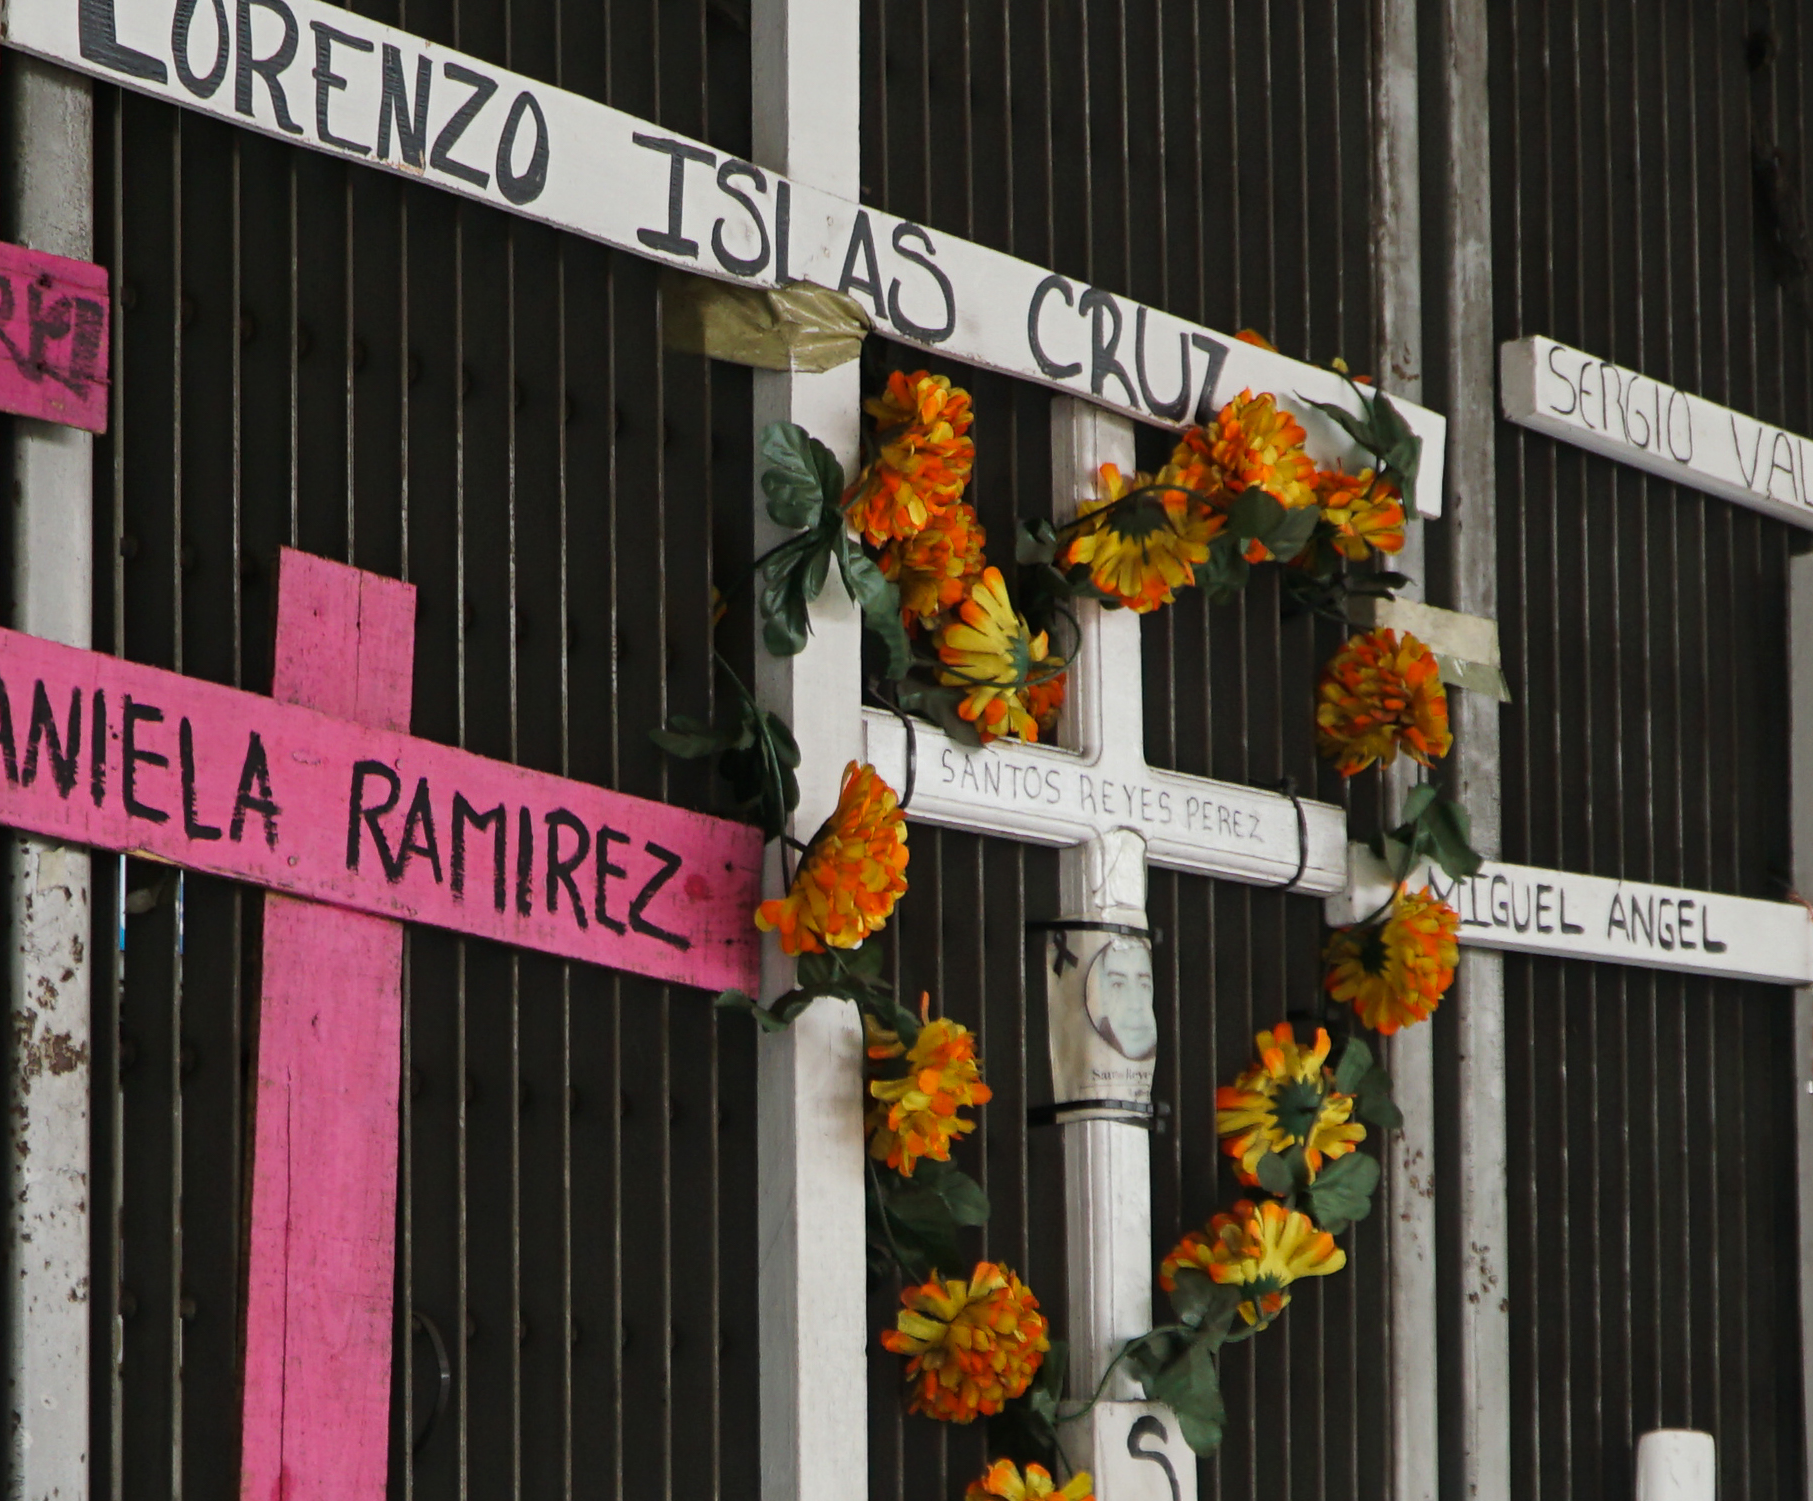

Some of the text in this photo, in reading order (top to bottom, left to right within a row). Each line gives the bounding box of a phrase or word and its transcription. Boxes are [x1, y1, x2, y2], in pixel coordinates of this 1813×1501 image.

[78, 0, 1231, 424] LORENZO ISLAS CRUZ
[1547, 344, 1694, 465] SERGIO
[344, 760, 692, 951] RAMIREZ
[941, 746, 1266, 845] SANTOS REYES PEREZ
